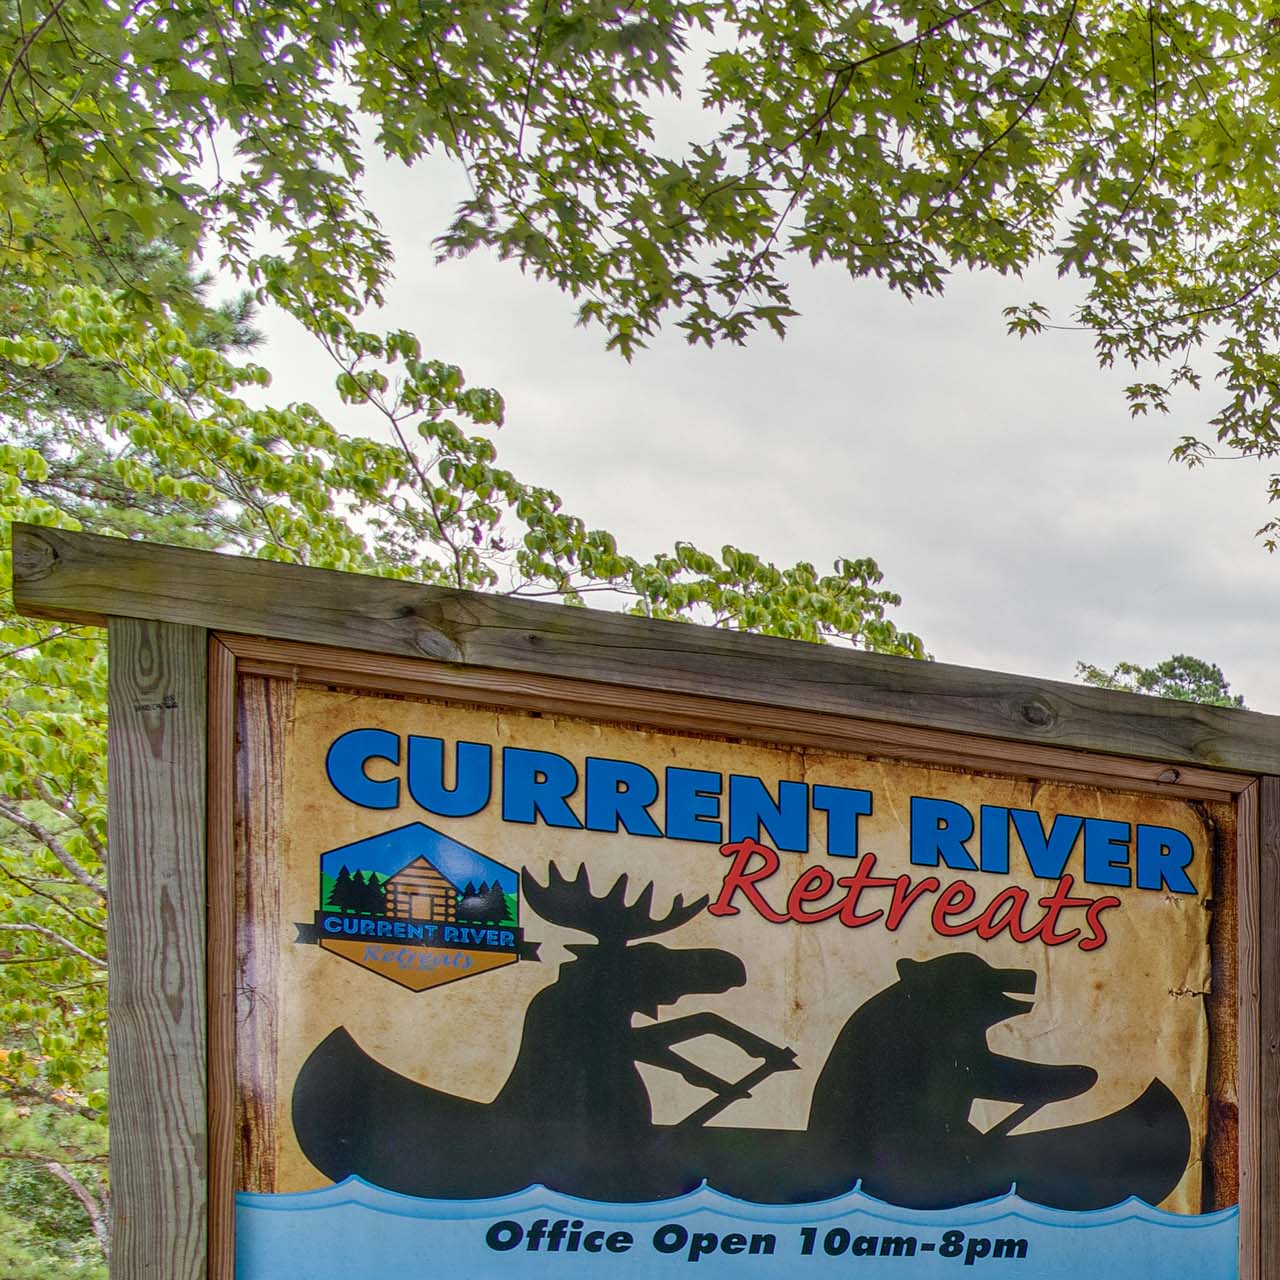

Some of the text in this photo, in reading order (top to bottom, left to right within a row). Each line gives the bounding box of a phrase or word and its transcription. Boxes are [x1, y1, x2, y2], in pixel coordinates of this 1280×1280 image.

[326, 728, 1199, 895] CURRENT RIVER
[324, 916, 516, 948] CURRENT RIVER
[708, 838, 1121, 951] Retreats
[485, 1219, 1029, 1266] Office Open 10am-8pm
